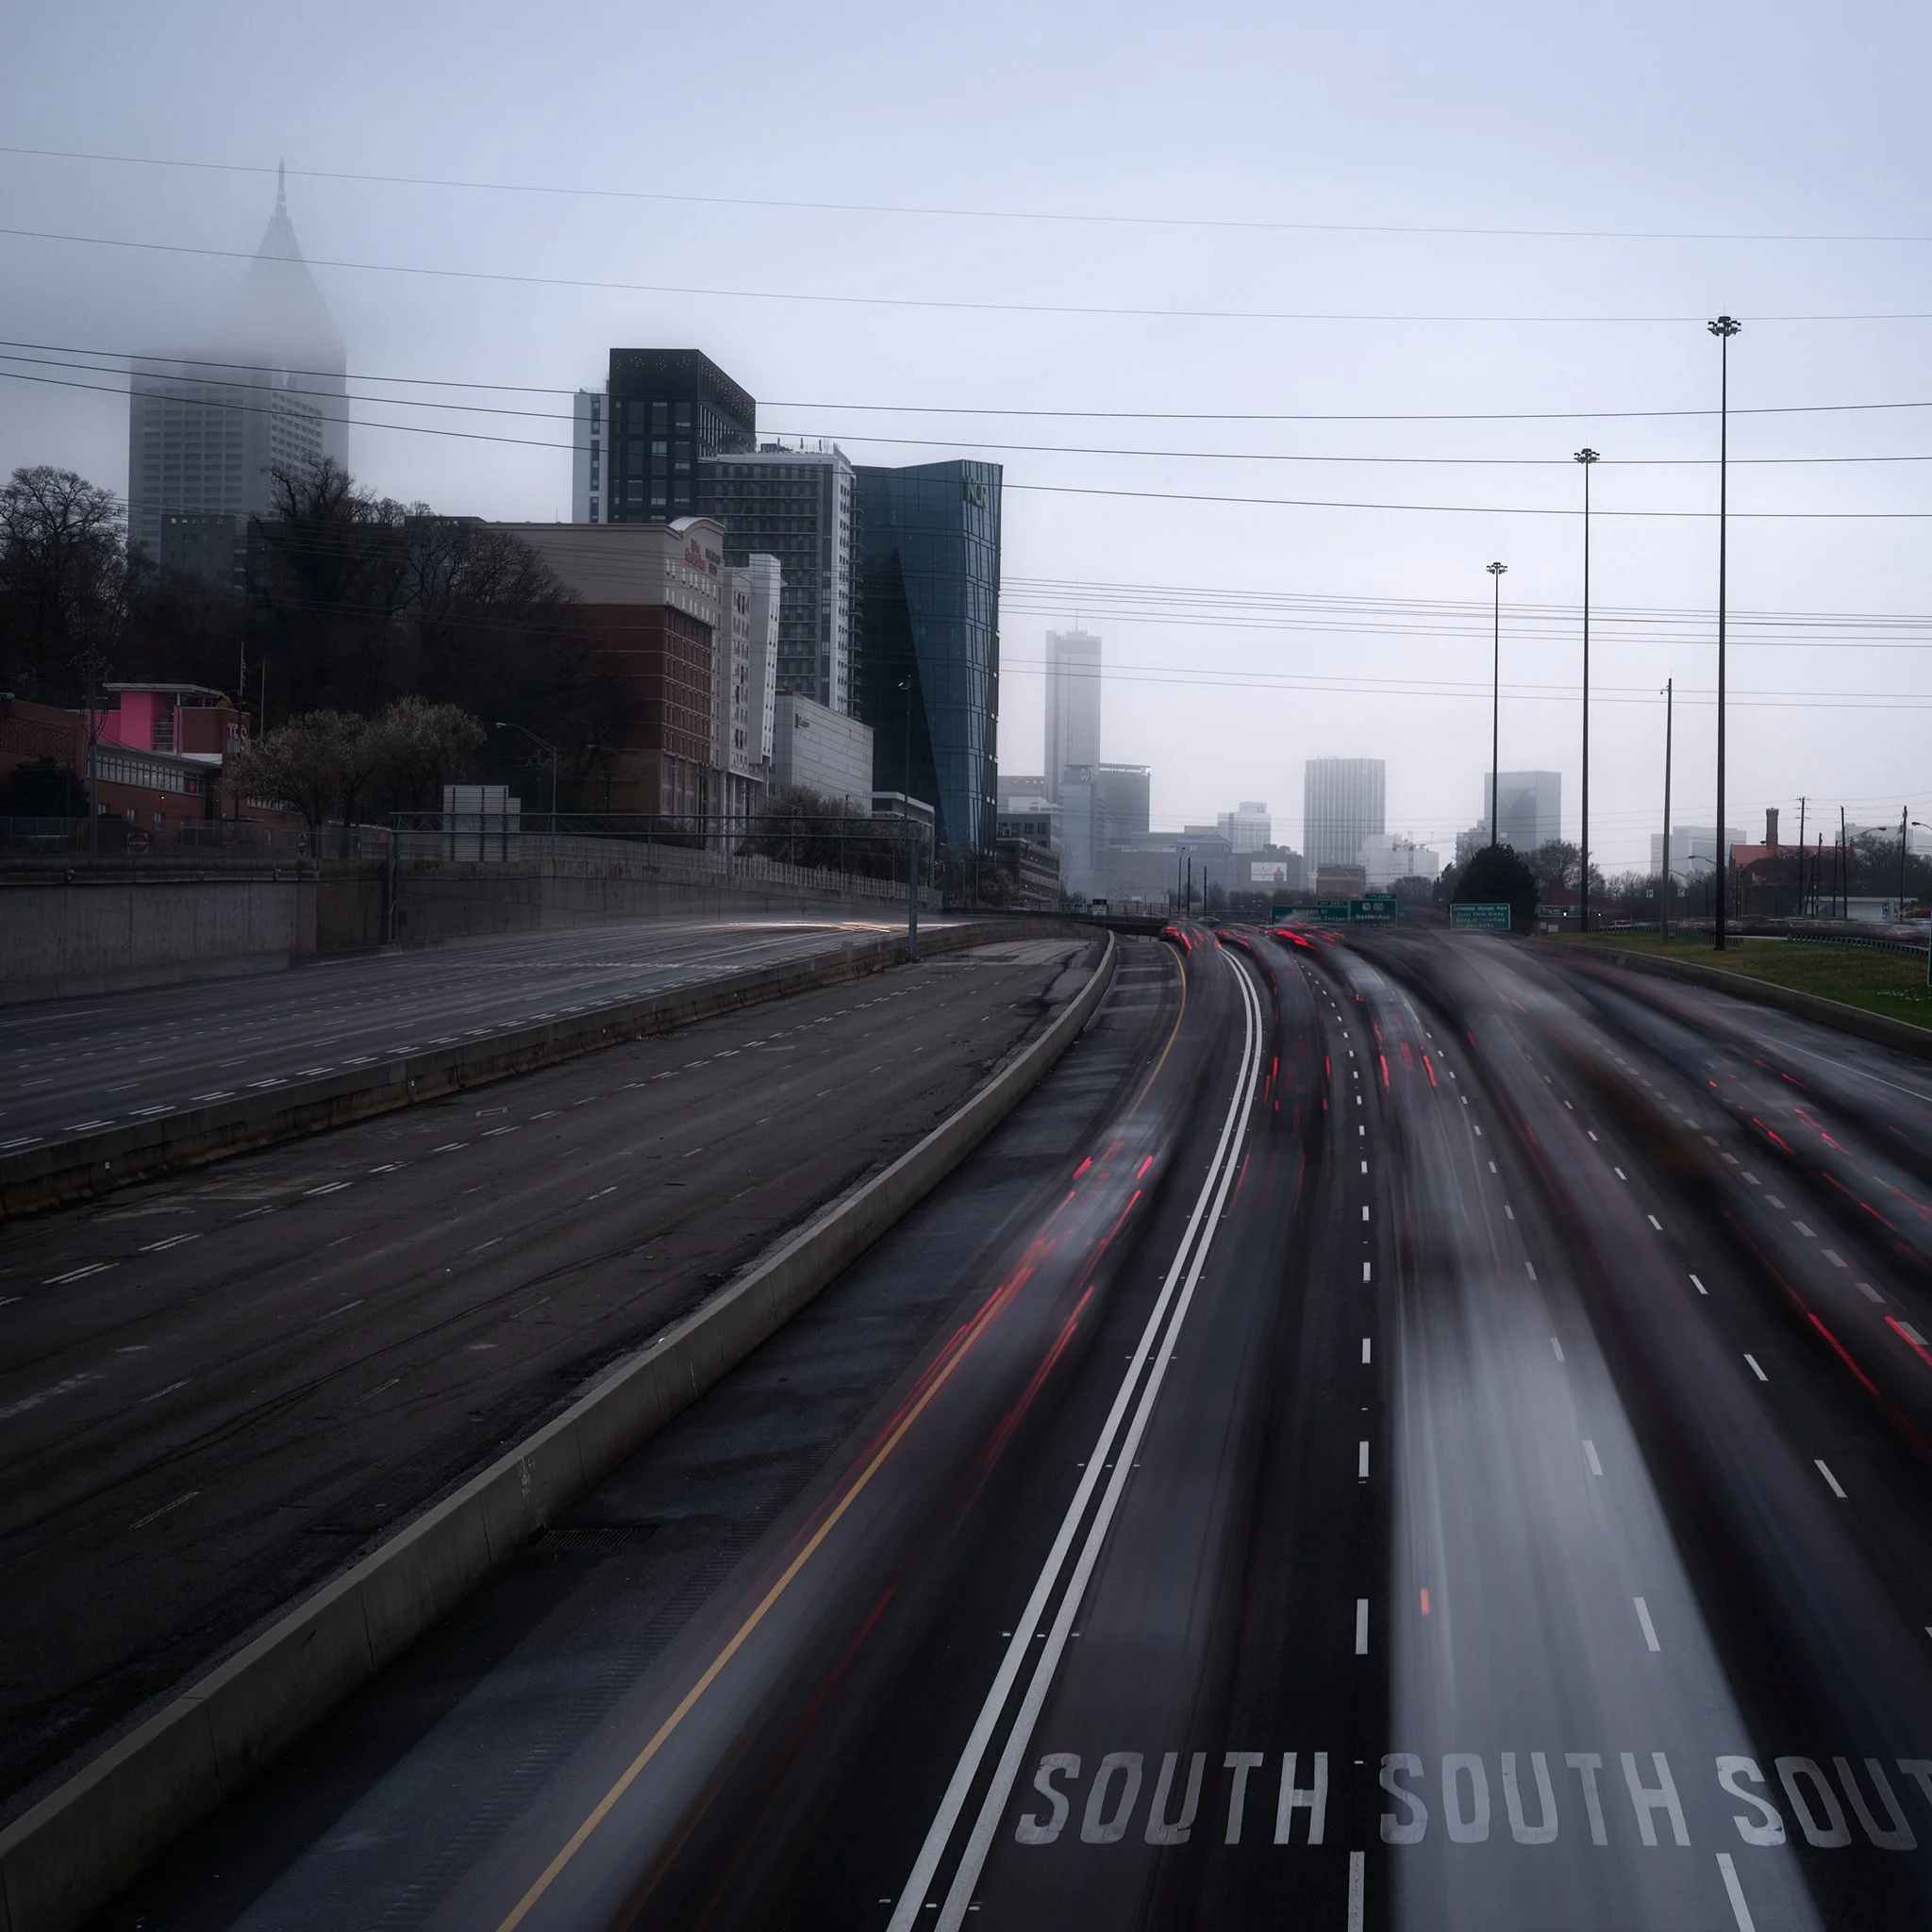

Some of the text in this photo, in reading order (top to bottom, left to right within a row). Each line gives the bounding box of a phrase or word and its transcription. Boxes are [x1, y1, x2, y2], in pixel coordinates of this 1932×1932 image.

[966, 482, 989, 508] NCR
[1014, 1751, 1329, 1845] SOUTH
[1379, 1751, 1691, 1847] SOUTH
